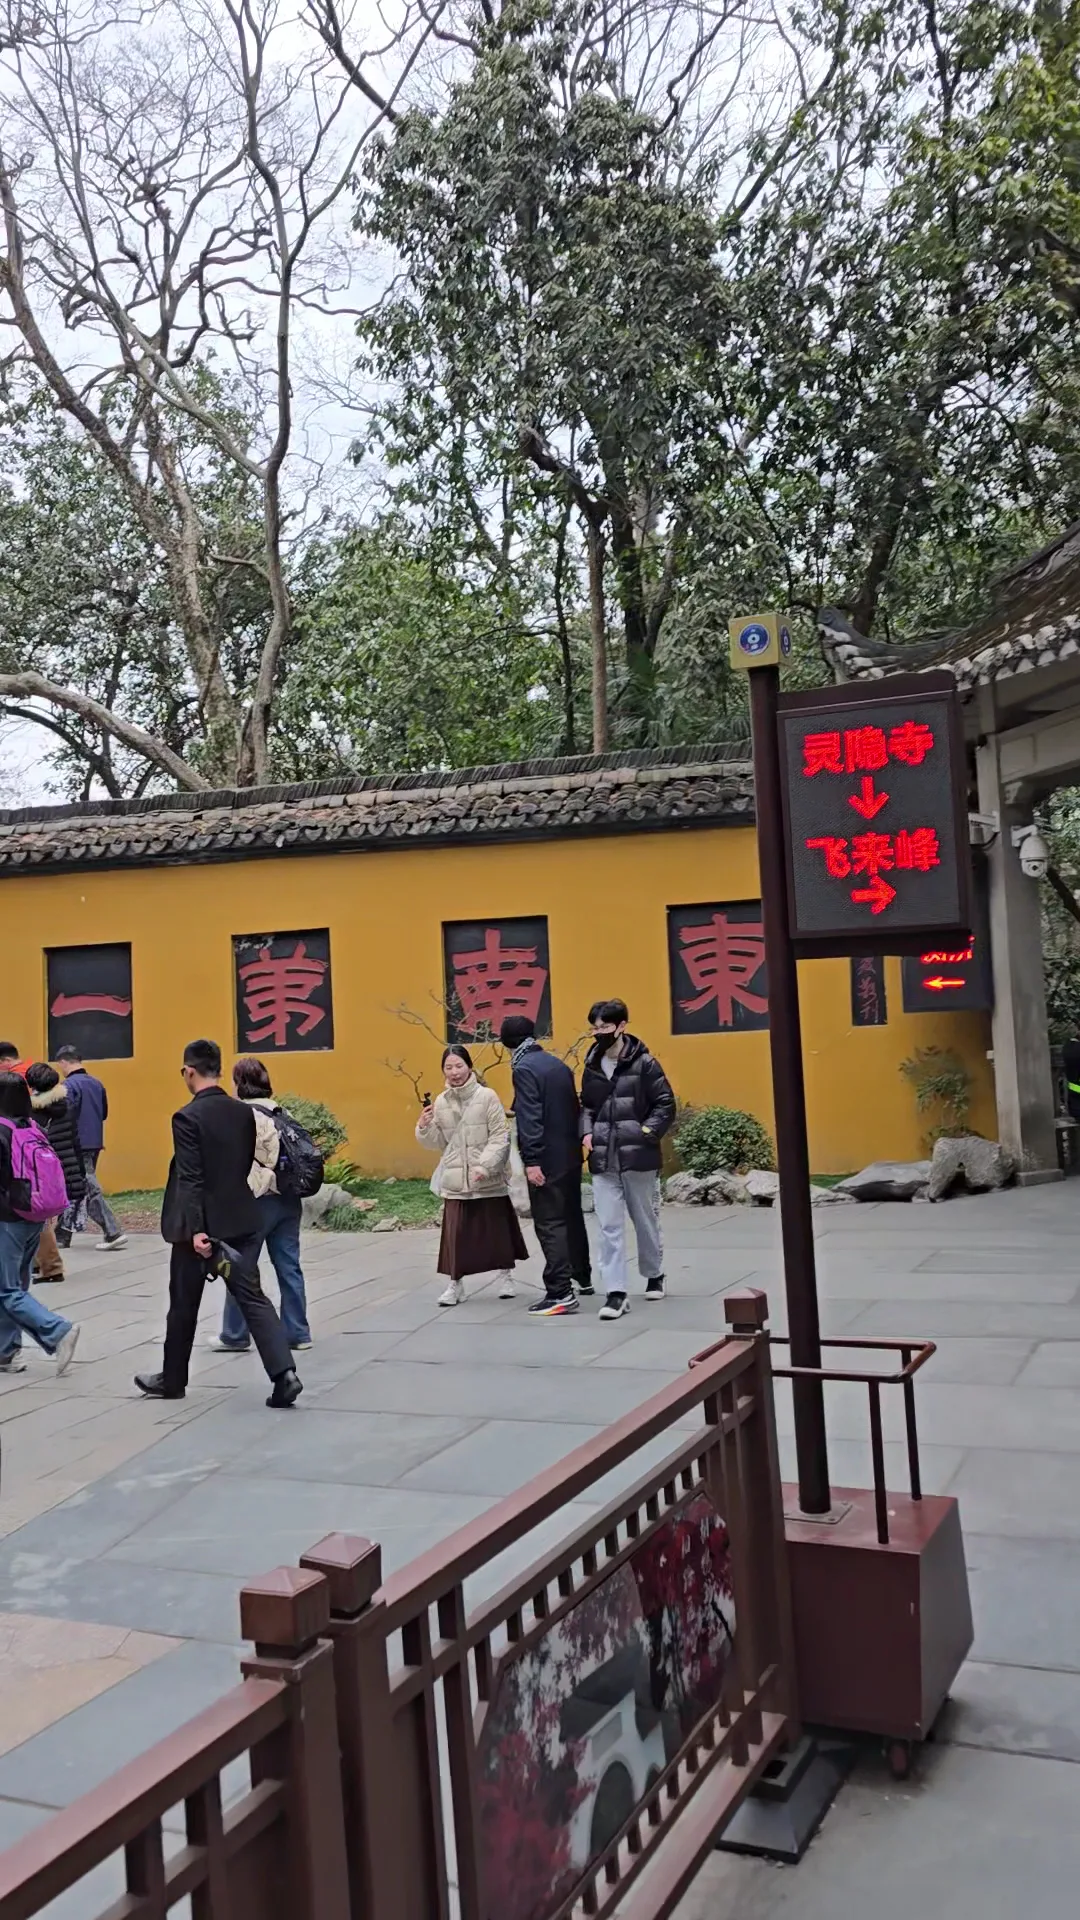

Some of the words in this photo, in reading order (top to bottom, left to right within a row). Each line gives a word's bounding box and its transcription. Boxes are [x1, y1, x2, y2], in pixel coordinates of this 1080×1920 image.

[802, 720, 934, 777] 灵隐寺
[805, 827, 940, 879] 飞来峰
[678, 911, 769, 1027] 東
[50, 993, 132, 1018] 一
